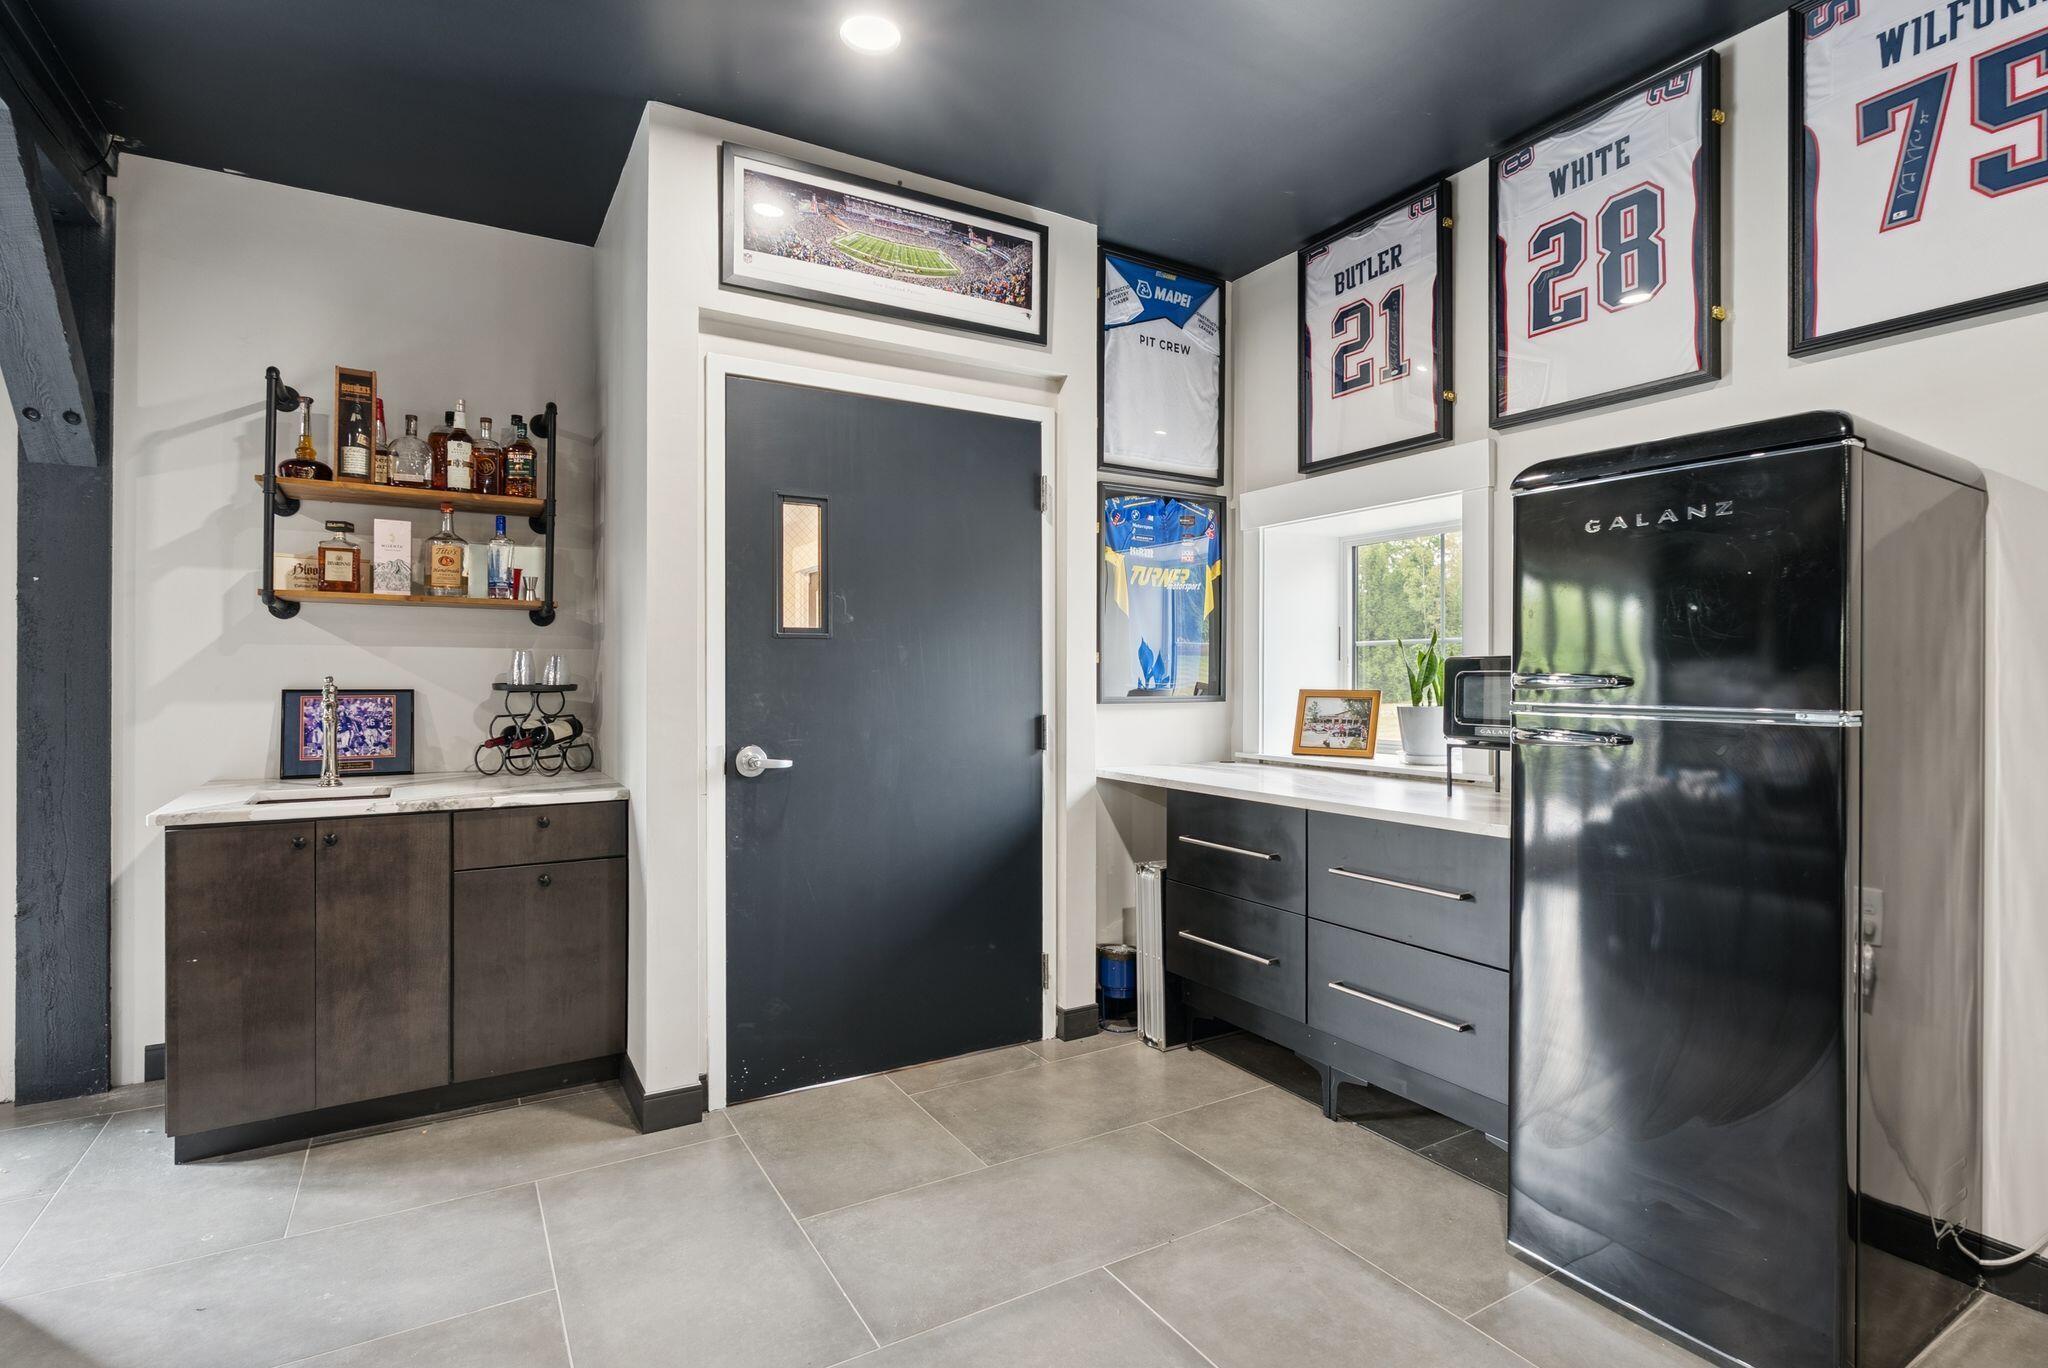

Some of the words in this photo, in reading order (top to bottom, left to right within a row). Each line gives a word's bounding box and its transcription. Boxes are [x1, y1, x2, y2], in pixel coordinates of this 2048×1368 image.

[1876, 0, 2048, 69] WILFOR
[1856, 26, 2048, 233] 75
[1549, 135, 1631, 198] WHITE
[1334, 244, 1402, 295] BUTLER
[1528, 181, 1667, 339] 28
[1154, 286, 1191, 308] MAPEI
[1140, 334, 1156, 347] PIT
[1159, 340, 1191, 355] CREW
[1331, 284, 1410, 399] 21
[1584, 500, 1734, 534] GALANZ
[435, 547, 457, 556] Tito's
[1130, 565, 1190, 588] TURNER
